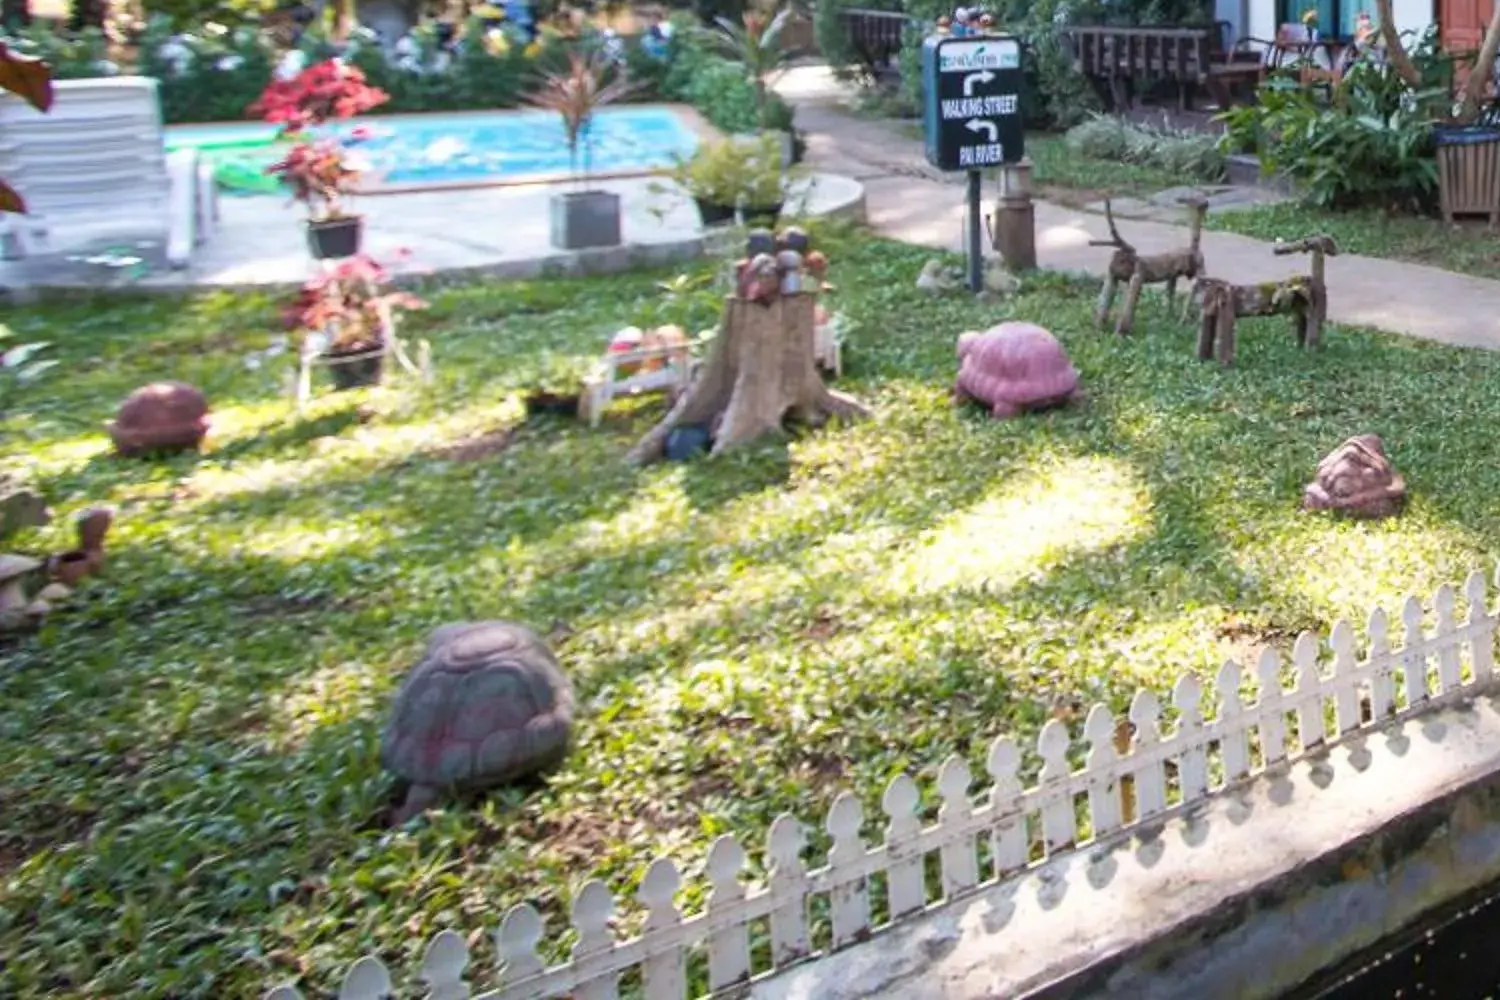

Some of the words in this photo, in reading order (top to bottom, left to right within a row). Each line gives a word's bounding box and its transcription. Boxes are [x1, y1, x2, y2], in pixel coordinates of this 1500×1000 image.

[941, 97, 983, 119] WALKING
[983, 94, 1018, 114] STREET
[975, 143, 1002, 164] RIVER
